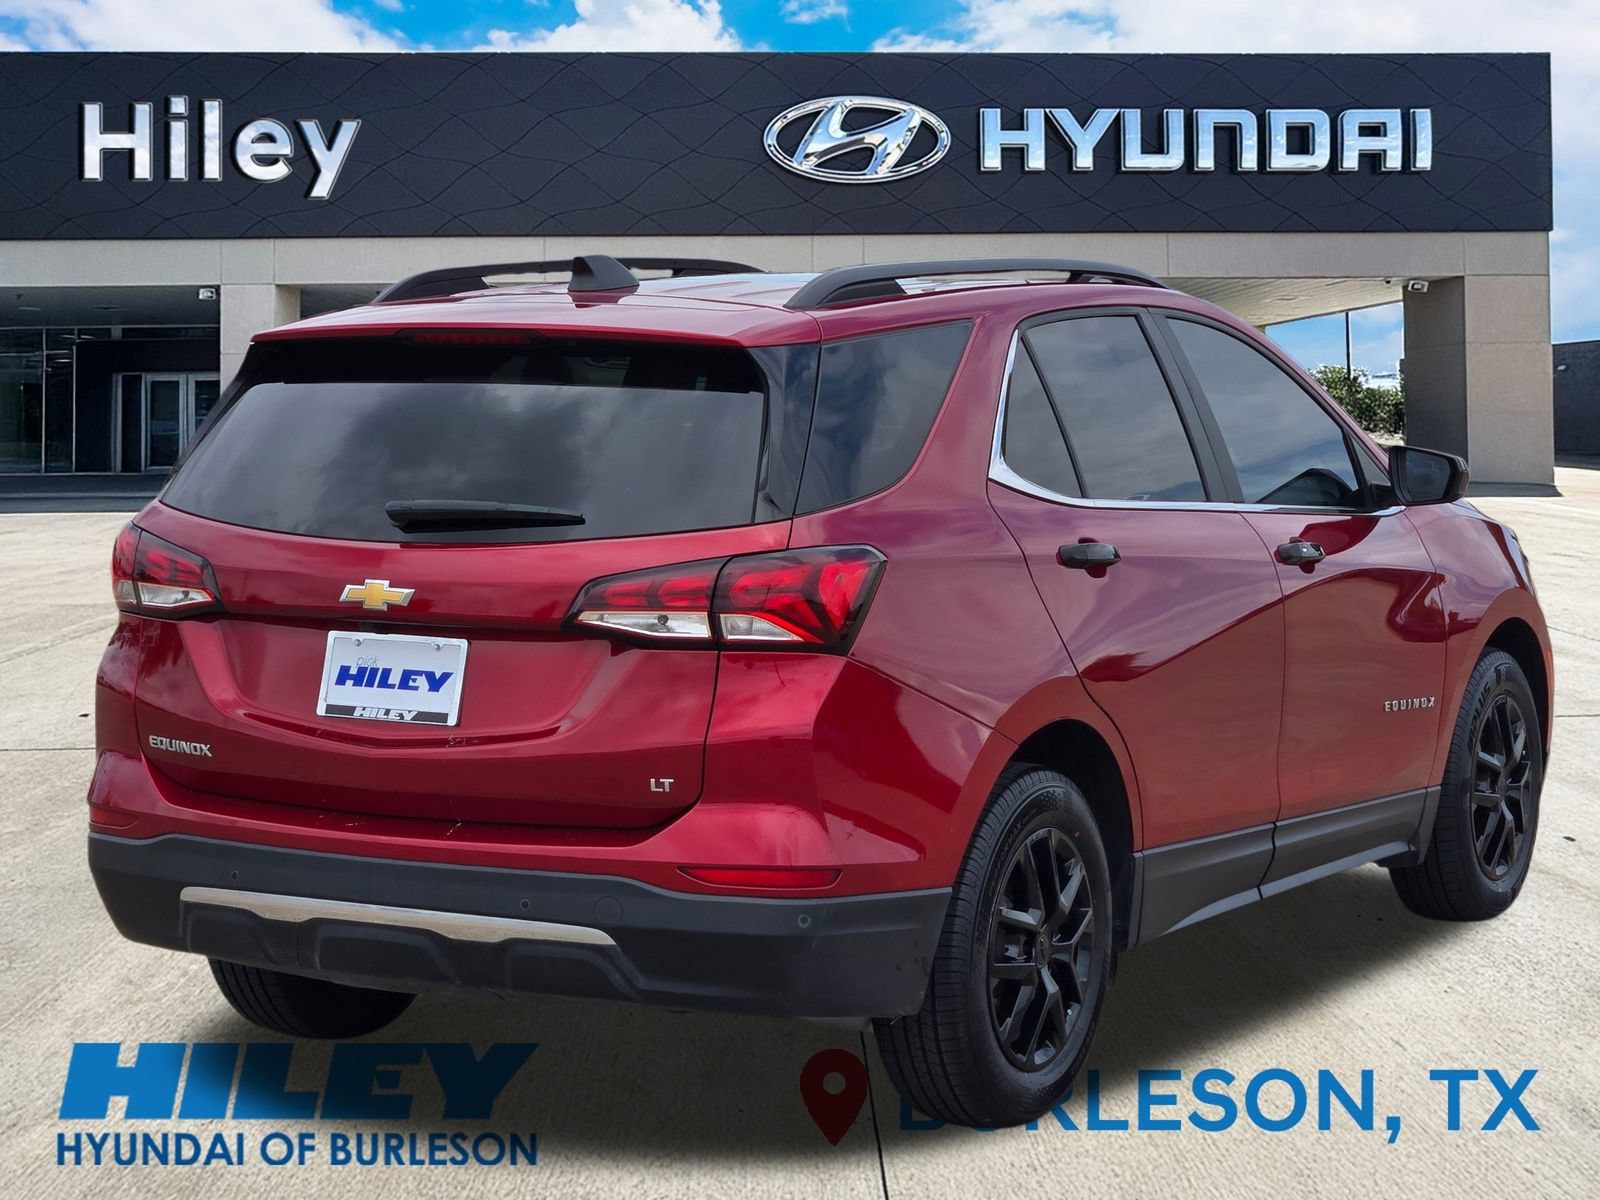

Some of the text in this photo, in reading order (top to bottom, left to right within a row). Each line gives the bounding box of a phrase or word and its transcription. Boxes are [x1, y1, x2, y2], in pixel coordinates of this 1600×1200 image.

[80, 95, 361, 200] Hiley
[979, 108, 1433, 172] HYUNDAI
[355, 655, 378, 668] pick
[335, 665, 454, 693] HILEY
[352, 706, 418, 721] HILEY
[1384, 696, 1436, 712] EQUINOX
[148, 735, 213, 758] EQUINOX
[650, 778, 675, 793] LT
